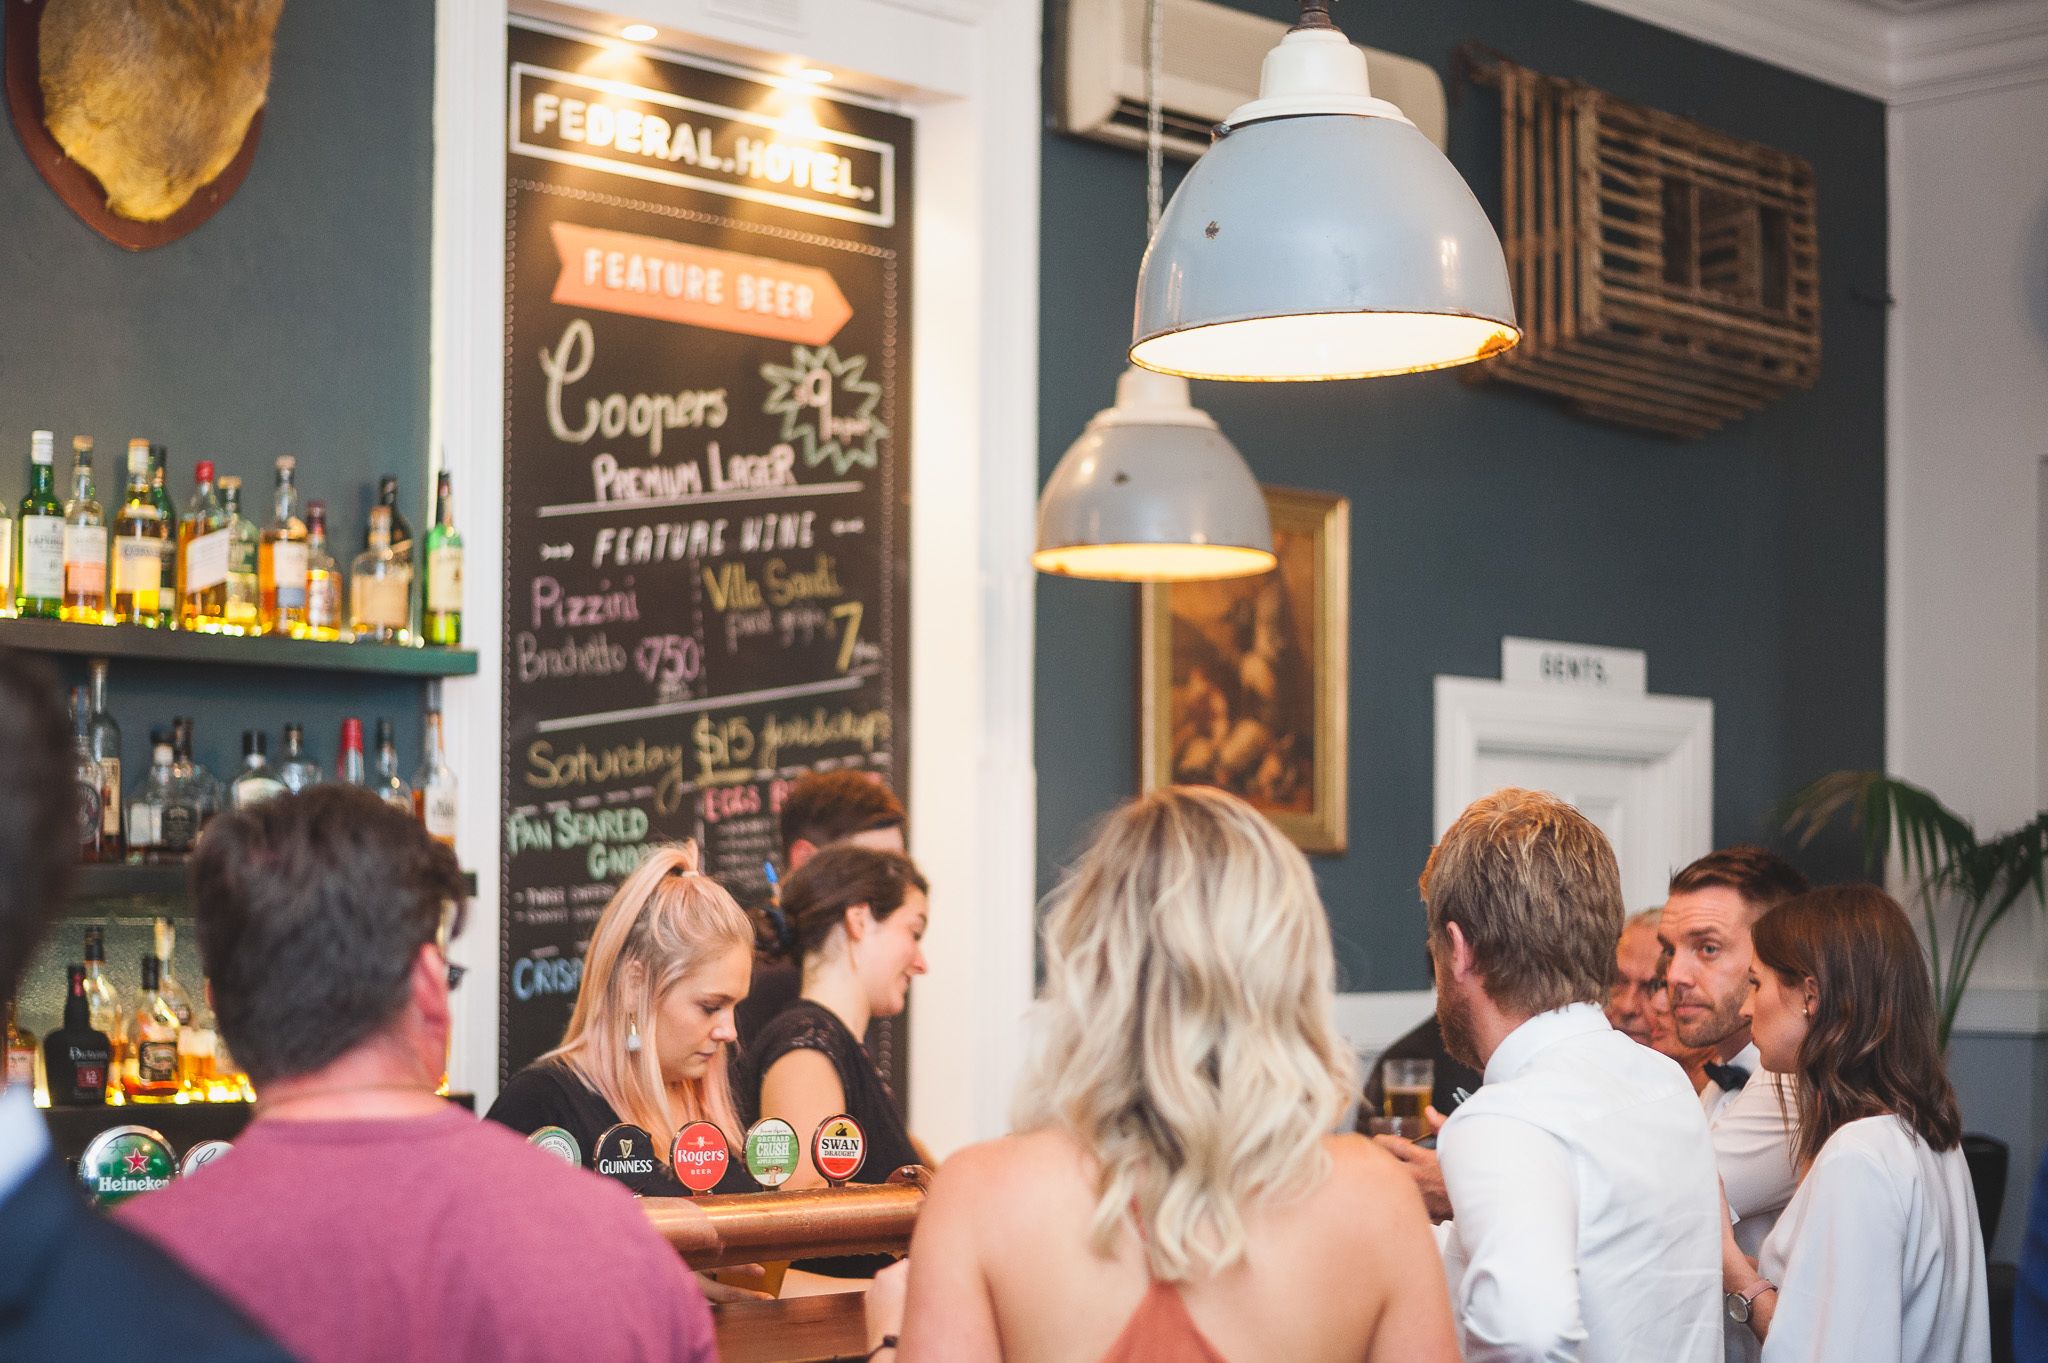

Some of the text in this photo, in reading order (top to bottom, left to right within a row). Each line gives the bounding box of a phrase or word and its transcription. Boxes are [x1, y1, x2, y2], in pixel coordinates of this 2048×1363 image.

[584, 247, 814, 320] FEATURE BEER
[539, 318, 728, 456] Coopers
[706, 440, 797, 491] LAGER
[592, 510, 817, 568] FEATURE WINE
[531, 574, 640, 630] Pizzini
[525, 738, 683, 816] Saturday
[508, 806, 649, 857] PAN SEARED
[756, 1142, 790, 1157] CRUSH
[757, 1135, 791, 1143] ORCHARD
[821, 1138, 860, 1150] SWAN
[599, 1158, 653, 1175] GUINNESS
[690, 1168, 712, 1176] BEER
